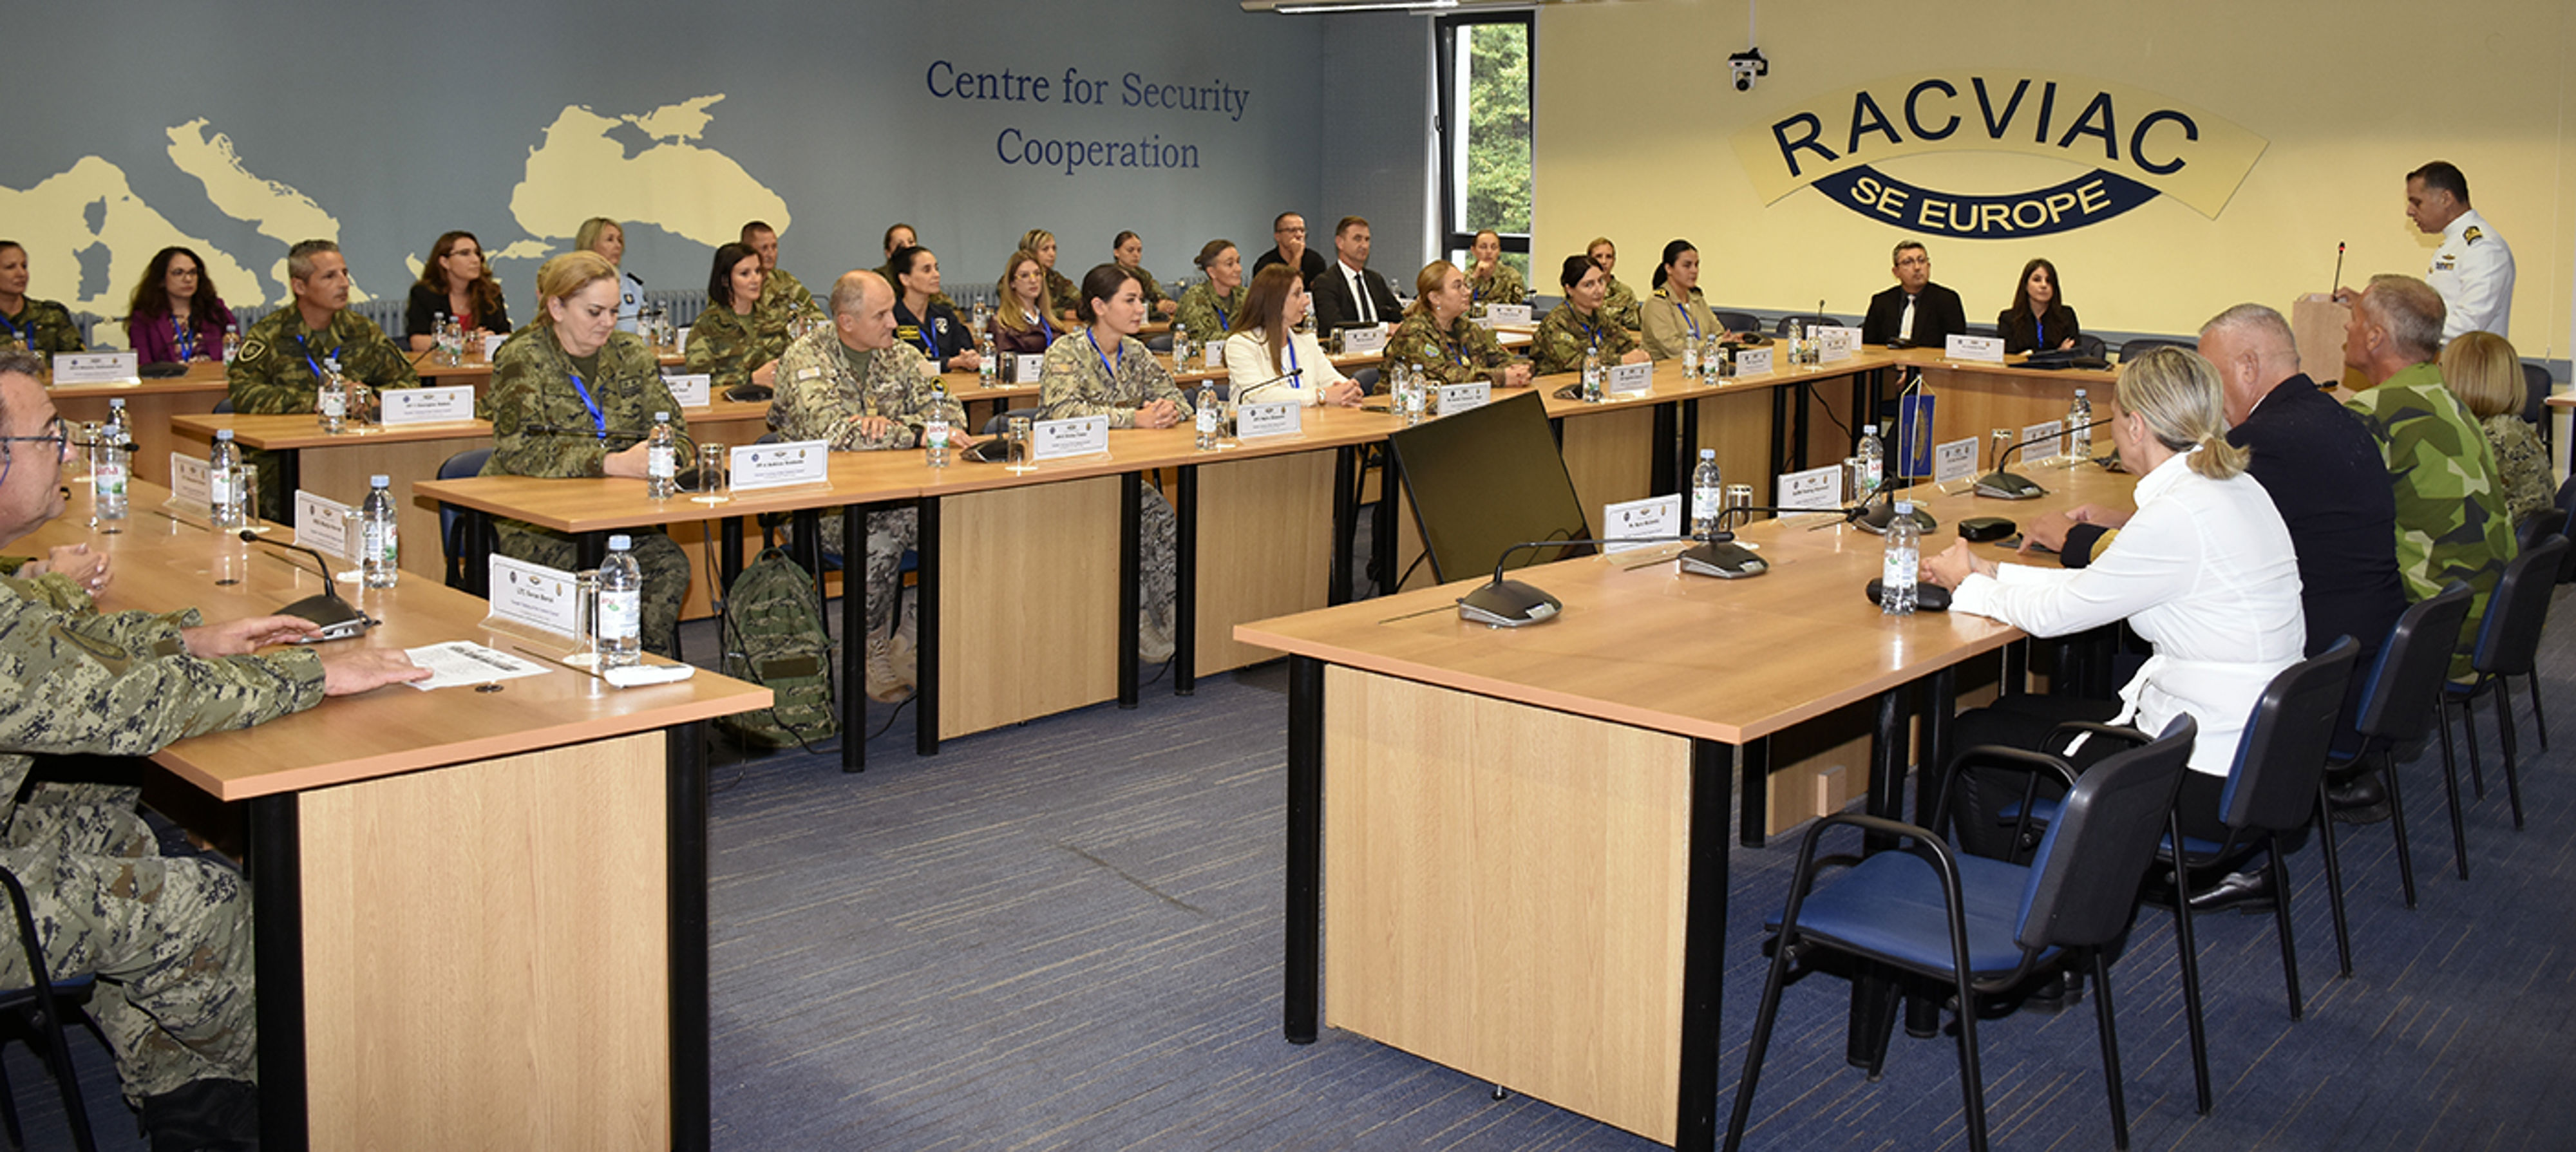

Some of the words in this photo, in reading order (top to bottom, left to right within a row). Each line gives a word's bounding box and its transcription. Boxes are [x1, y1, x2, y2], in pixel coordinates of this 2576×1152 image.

[926, 60, 1050, 102] Centre
[1062, 67, 1109, 105] for
[1122, 72, 1250, 122] Security
[996, 127, 1200, 176] Cooperation
[1772, 77, 2198, 177] RACVIAC
[1851, 177, 1909, 218] SE
[1918, 179, 2111, 232] EUROPE
